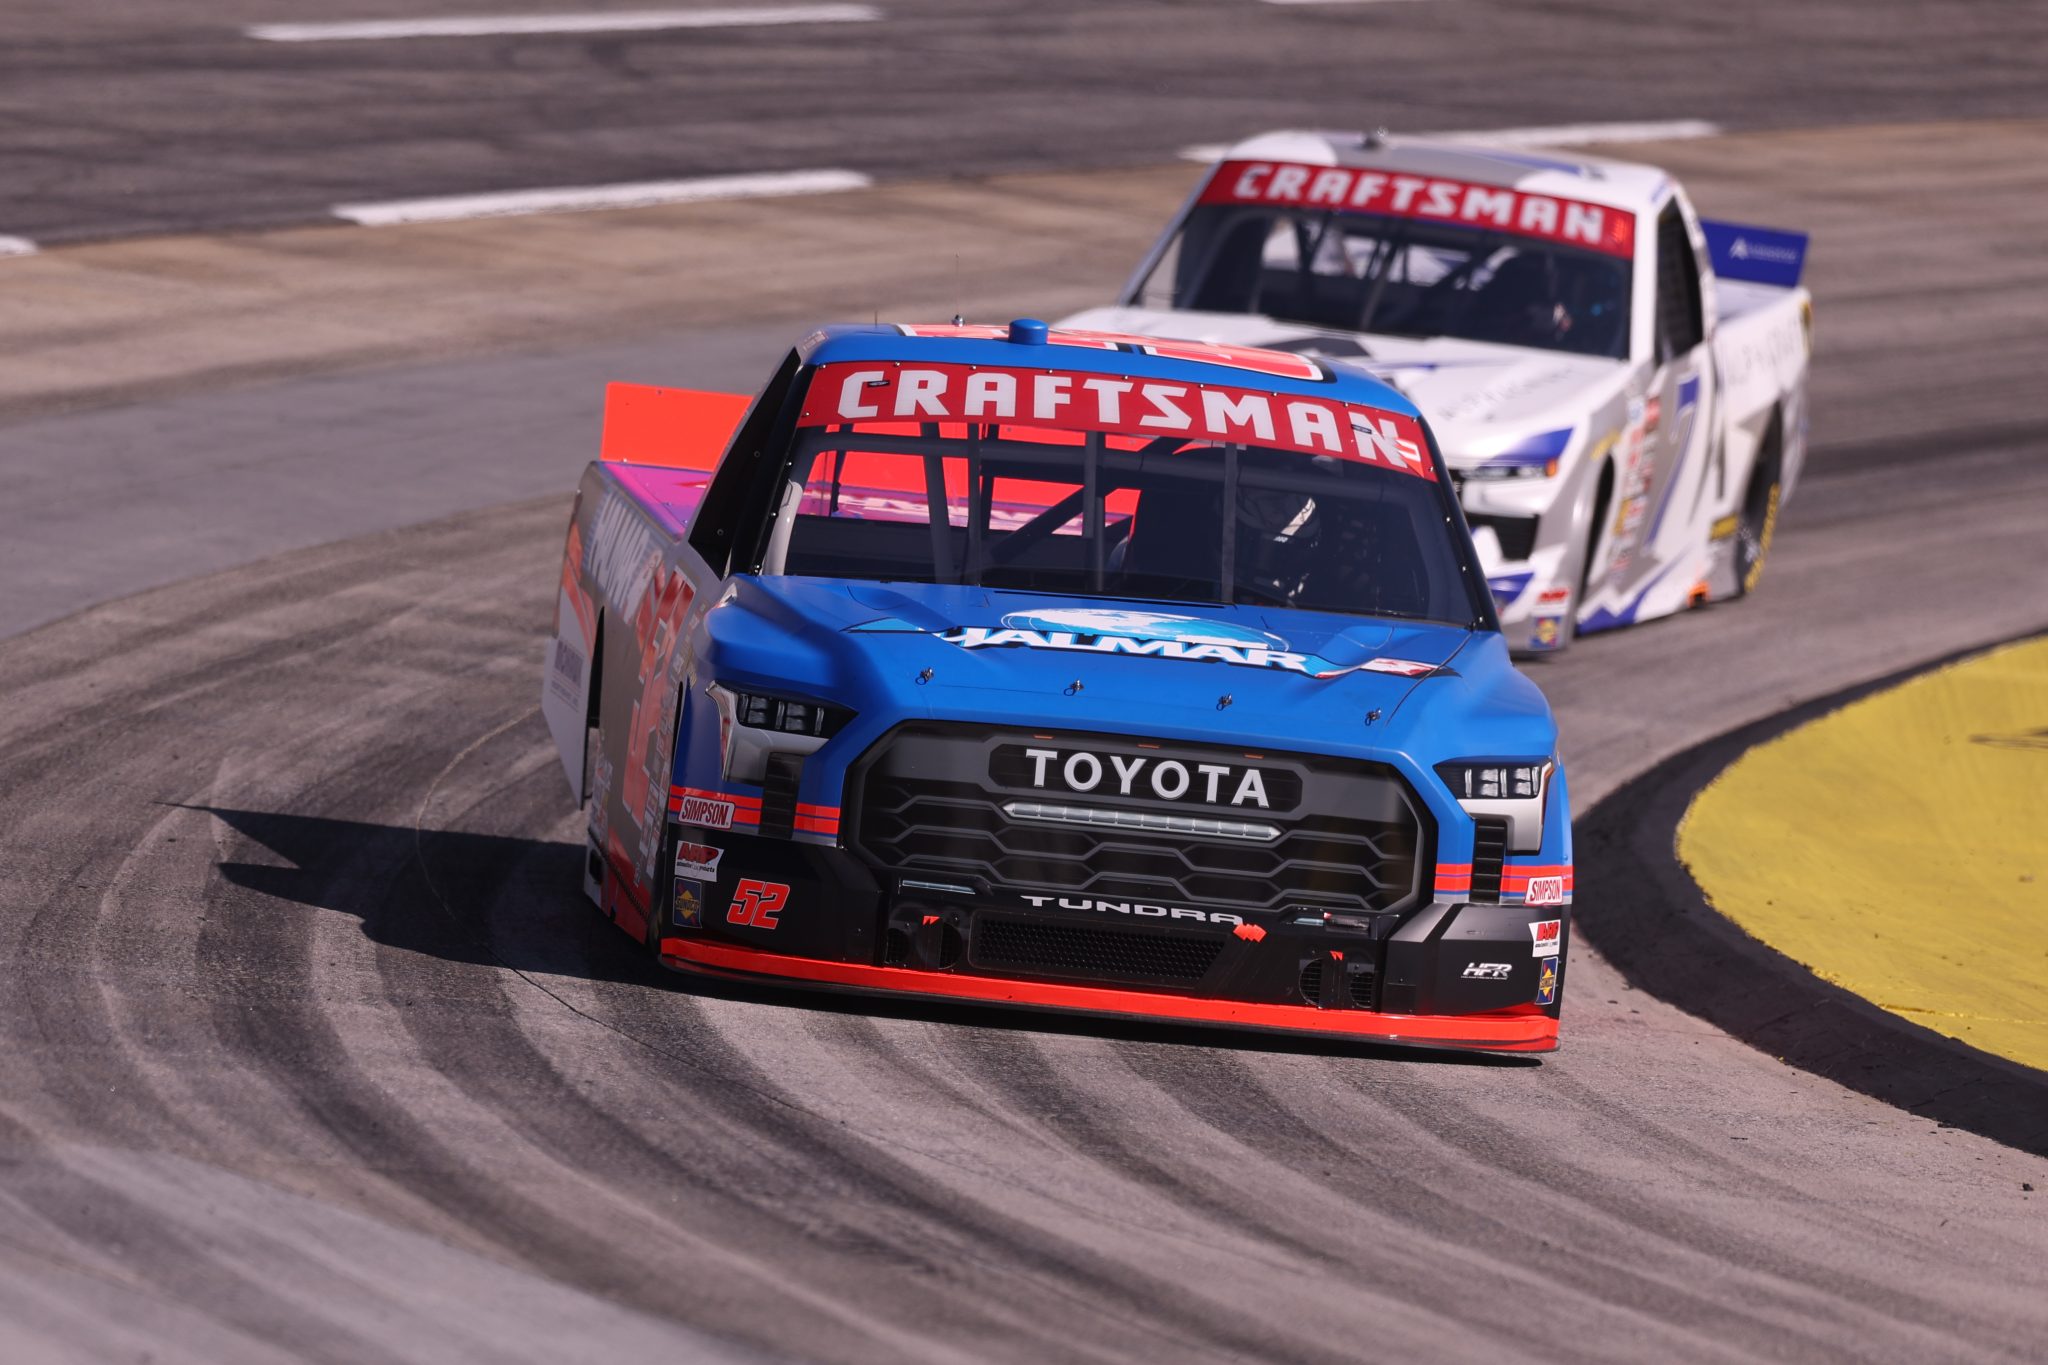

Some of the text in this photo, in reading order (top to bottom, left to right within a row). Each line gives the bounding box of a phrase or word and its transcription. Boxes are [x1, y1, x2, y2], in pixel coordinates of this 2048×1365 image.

[1233, 163, 1604, 245] CRAFTSMAN
[837, 370, 1408, 469] CRAFTSMAN
[1026, 748, 1269, 809] TOYOTA
[681, 798, 729, 826] SIMPSON
[726, 878, 790, 930] 52
[1020, 895, 1244, 926] TUNDRA
[1530, 879, 1561, 901] SIMPSON
[1463, 962, 1512, 978] HFR
